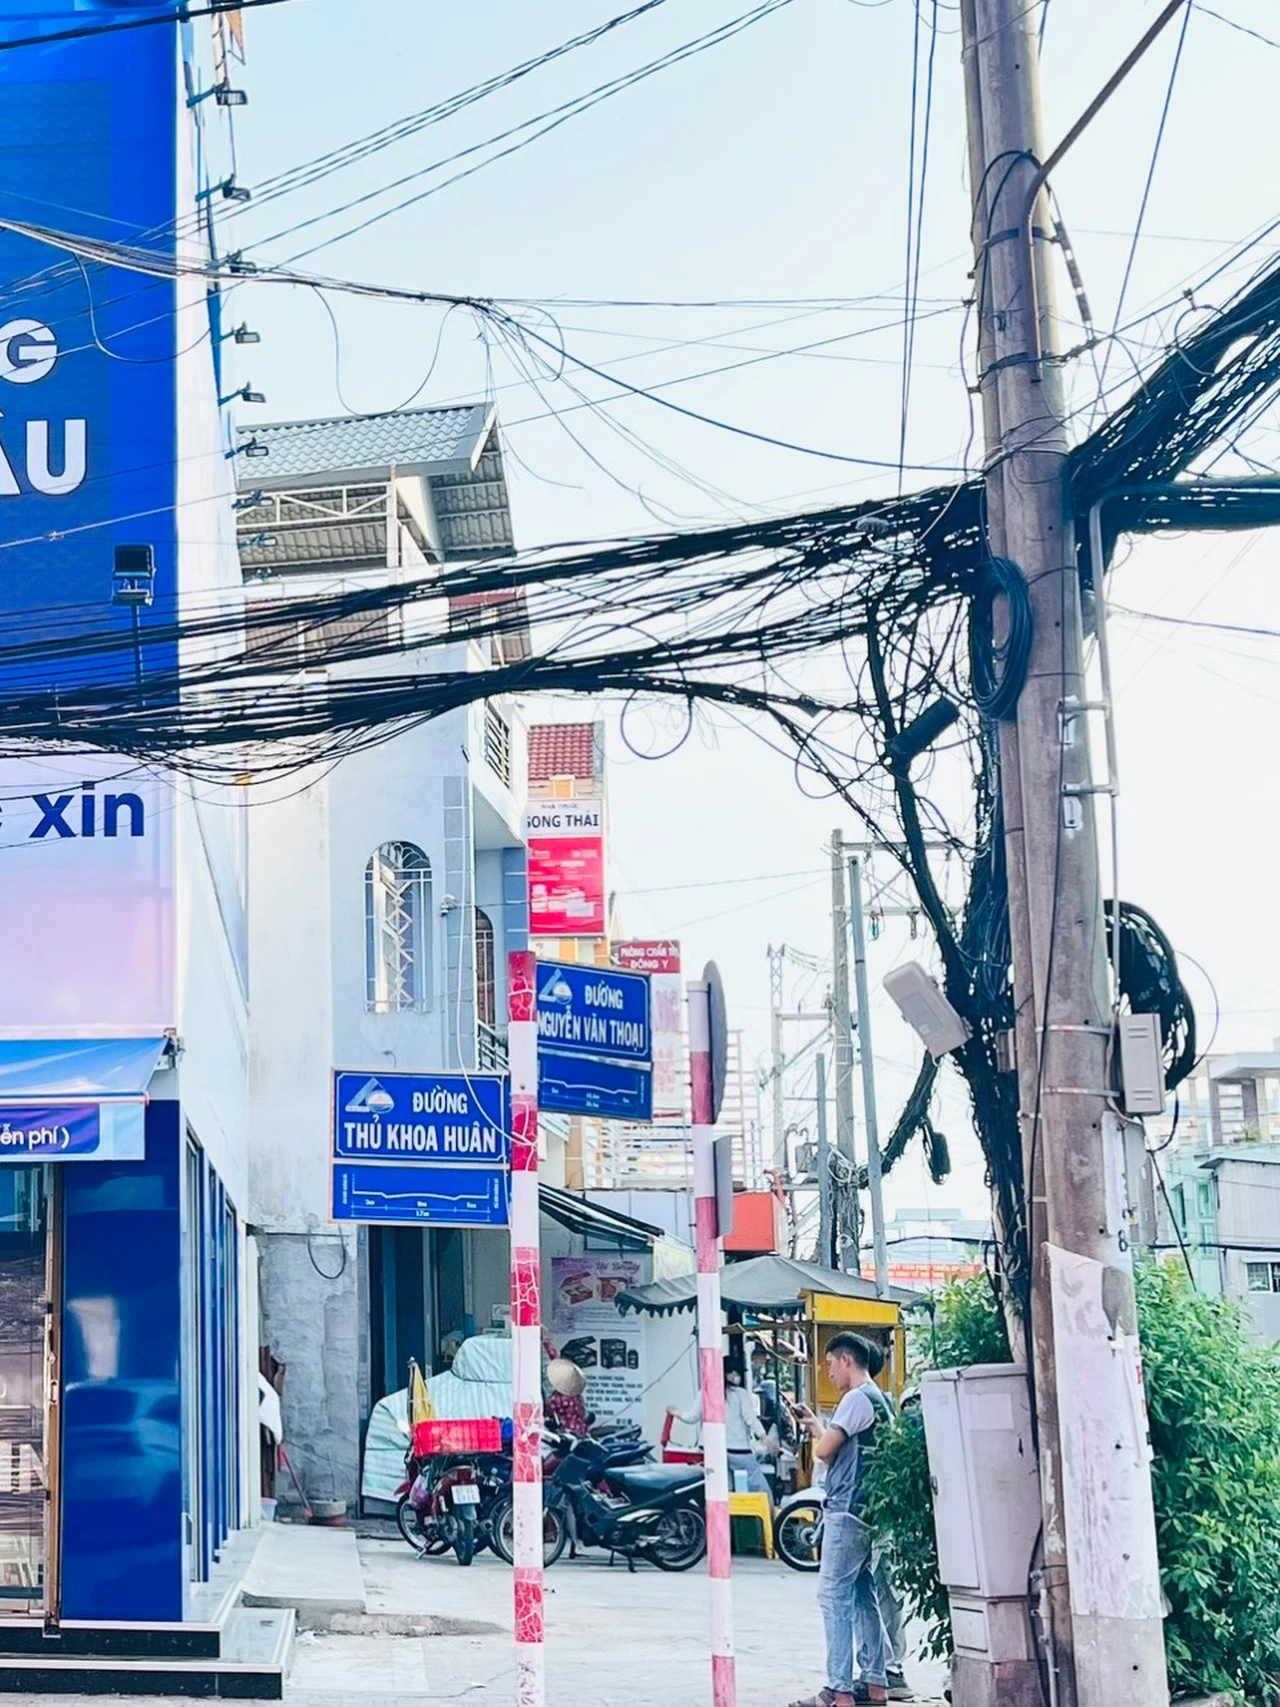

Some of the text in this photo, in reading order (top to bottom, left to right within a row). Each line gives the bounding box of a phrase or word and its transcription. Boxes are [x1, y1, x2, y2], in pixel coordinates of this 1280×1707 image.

[29, 782, 145, 838] xin
[565, 810, 599, 827] THÁI
[585, 980, 624, 1010] ĐƯỜNG
[537, 1005, 645, 1052] NGUYỄN VĂN THOẠI
[412, 1085, 468, 1114] ĐƯỜNG
[344, 1114, 496, 1153] THỦ KHOA HUÂN
